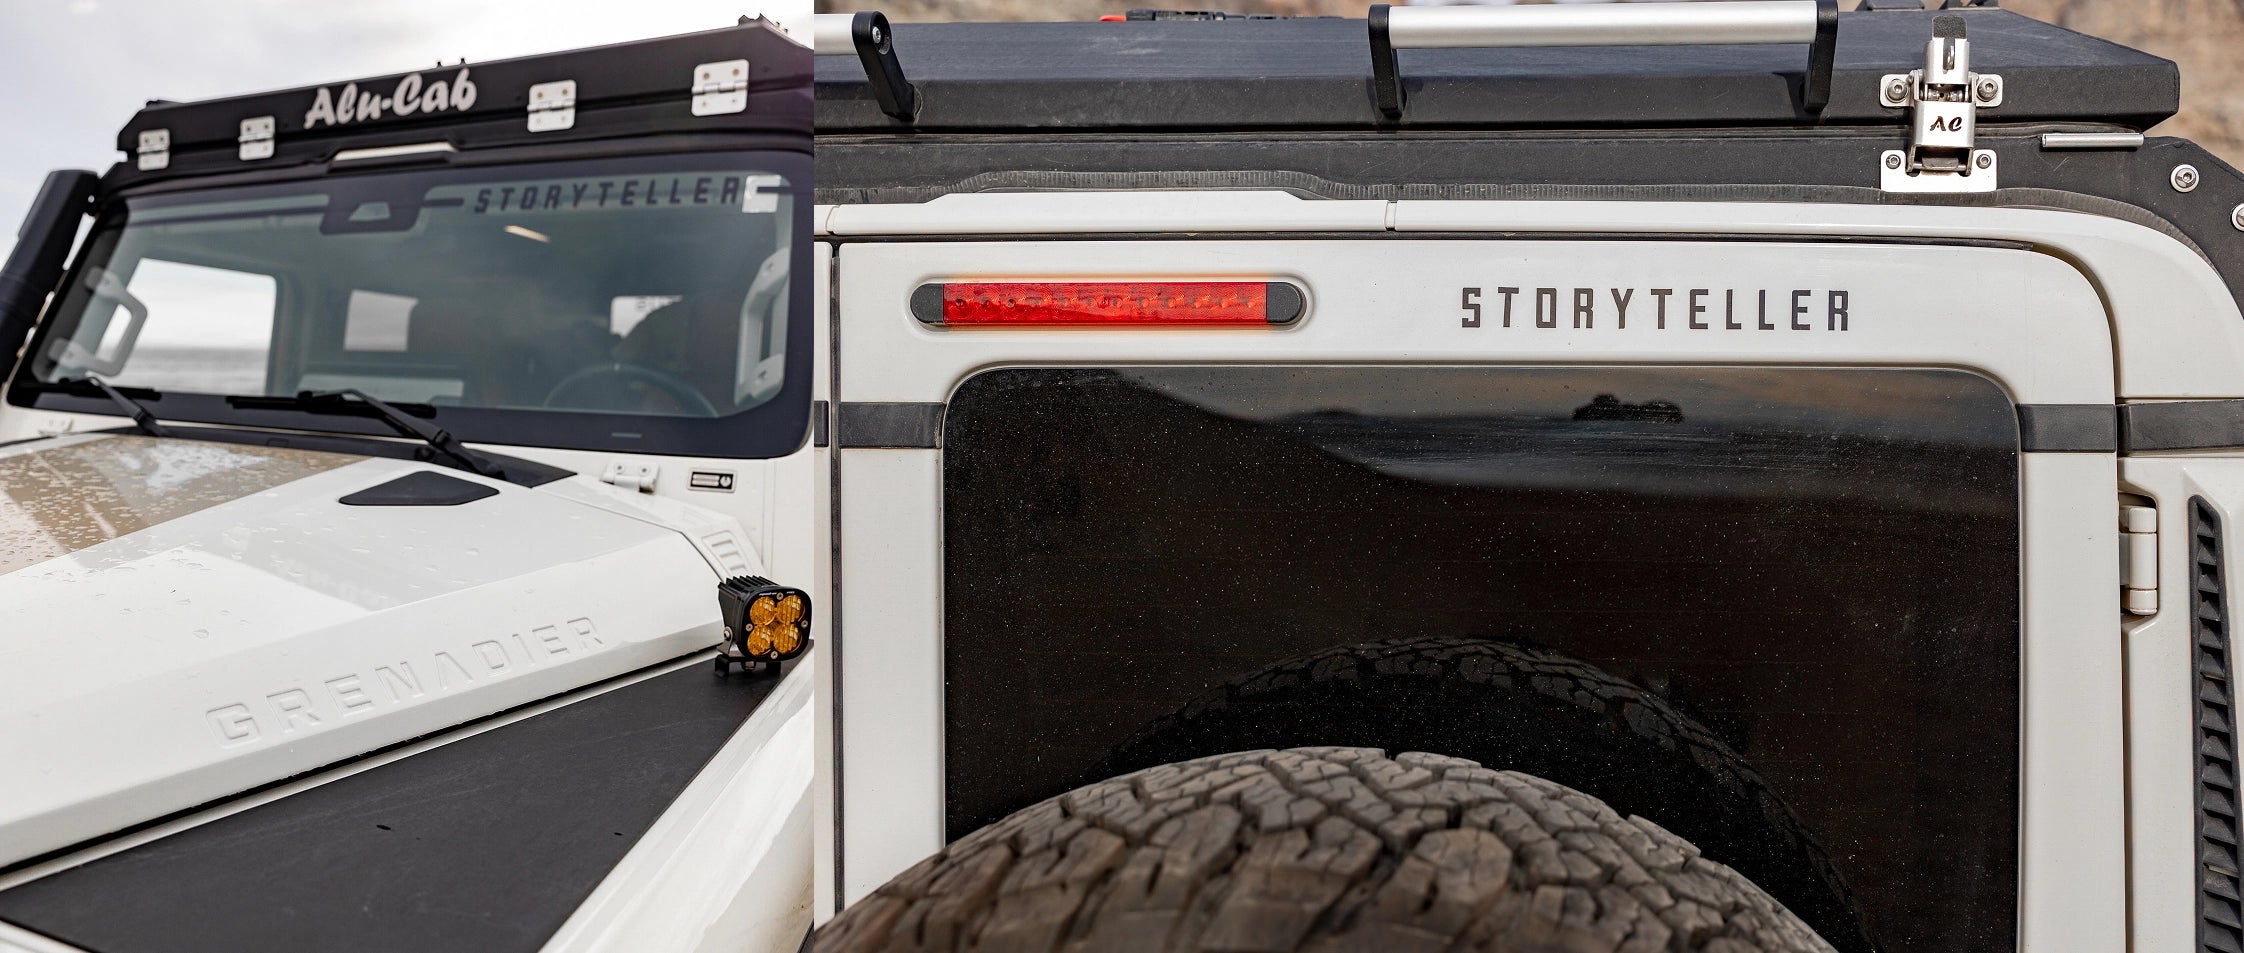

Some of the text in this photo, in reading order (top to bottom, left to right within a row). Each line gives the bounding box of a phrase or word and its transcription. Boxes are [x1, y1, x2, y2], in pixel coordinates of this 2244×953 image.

[303, 67, 477, 130] Alu-Cab
[1929, 115, 1963, 132] AC
[474, 176, 740, 214] STORYTELLER
[1461, 286, 1849, 332] STORYTELLER
[205, 616, 604, 749] GRENADIER
